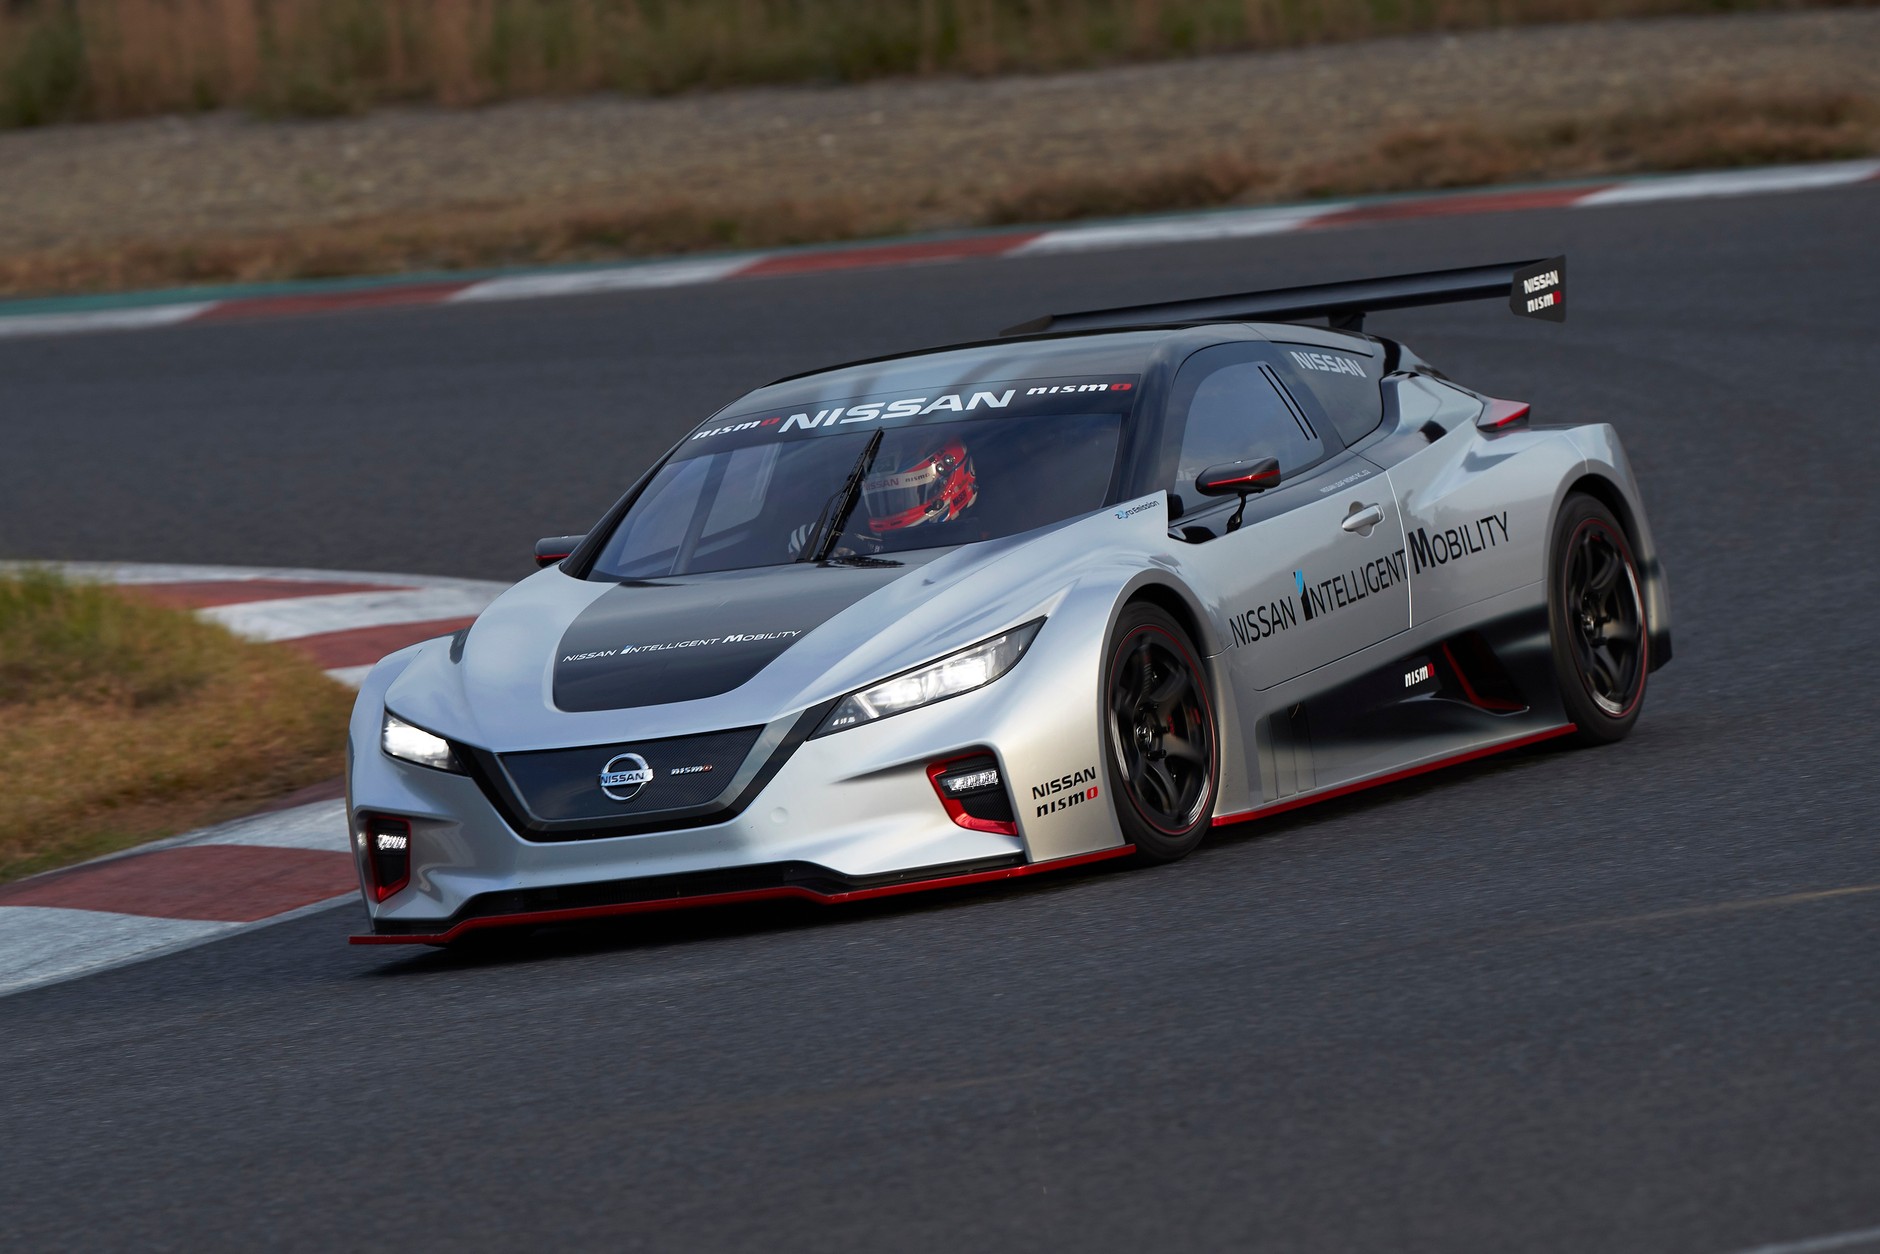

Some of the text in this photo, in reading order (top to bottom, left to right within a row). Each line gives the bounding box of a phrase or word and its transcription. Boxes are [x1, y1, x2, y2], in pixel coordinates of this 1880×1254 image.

[1523, 269, 1559, 294] NISSAN
[1527, 290, 1562, 313] nismo
[1290, 351, 1367, 378] NISSAN
[691, 383, 1132, 441] nismo NISSAN nismo
[1229, 511, 1509, 648] NISSAN INTELLIGENT MOBILITY
[562, 650, 617, 662] NISSAN
[722, 630, 802, 643] MOBILITY
[1404, 662, 1435, 688] nismo
[601, 772, 645, 784] NISSAN
[670, 764, 713, 776] nismo
[1032, 766, 1096, 800] NISSAN
[1036, 785, 1098, 818] nismo
